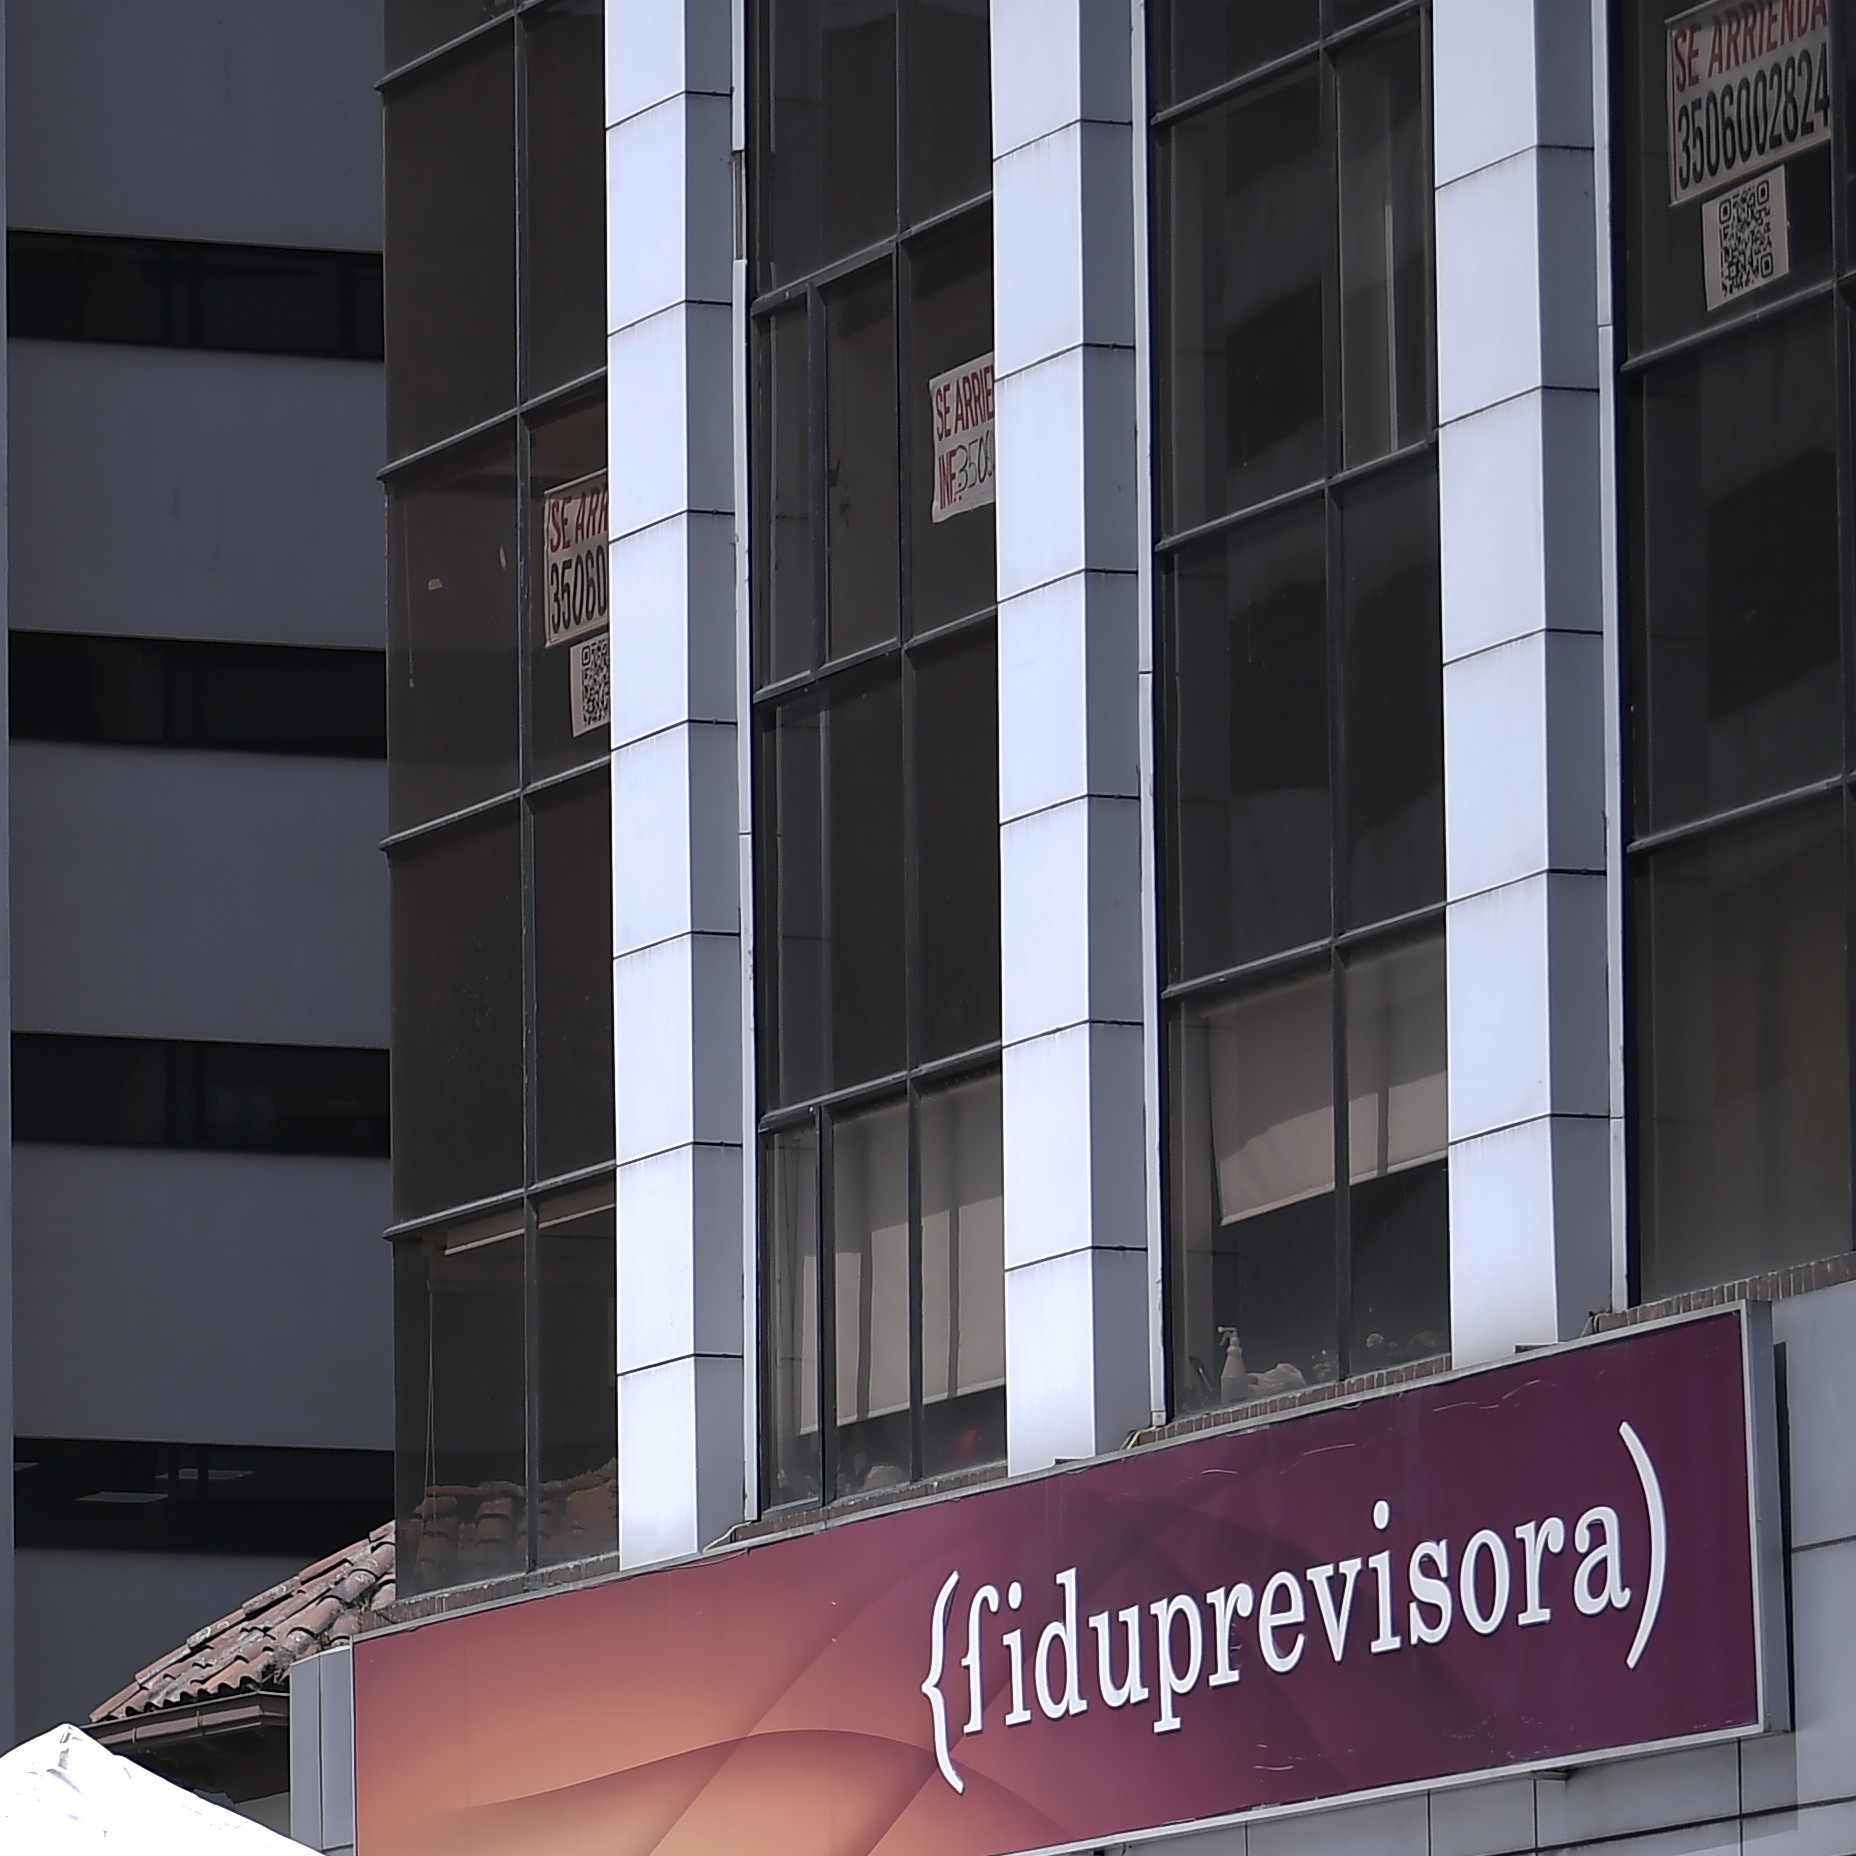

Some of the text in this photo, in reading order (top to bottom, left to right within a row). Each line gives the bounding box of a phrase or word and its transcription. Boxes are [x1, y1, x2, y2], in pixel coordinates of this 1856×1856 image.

[1674, 23, 1701, 92] SE
[1678, 42, 1830, 190] 3506002824
[936, 383, 951, 441] SE
[550, 496, 571, 553] SE
